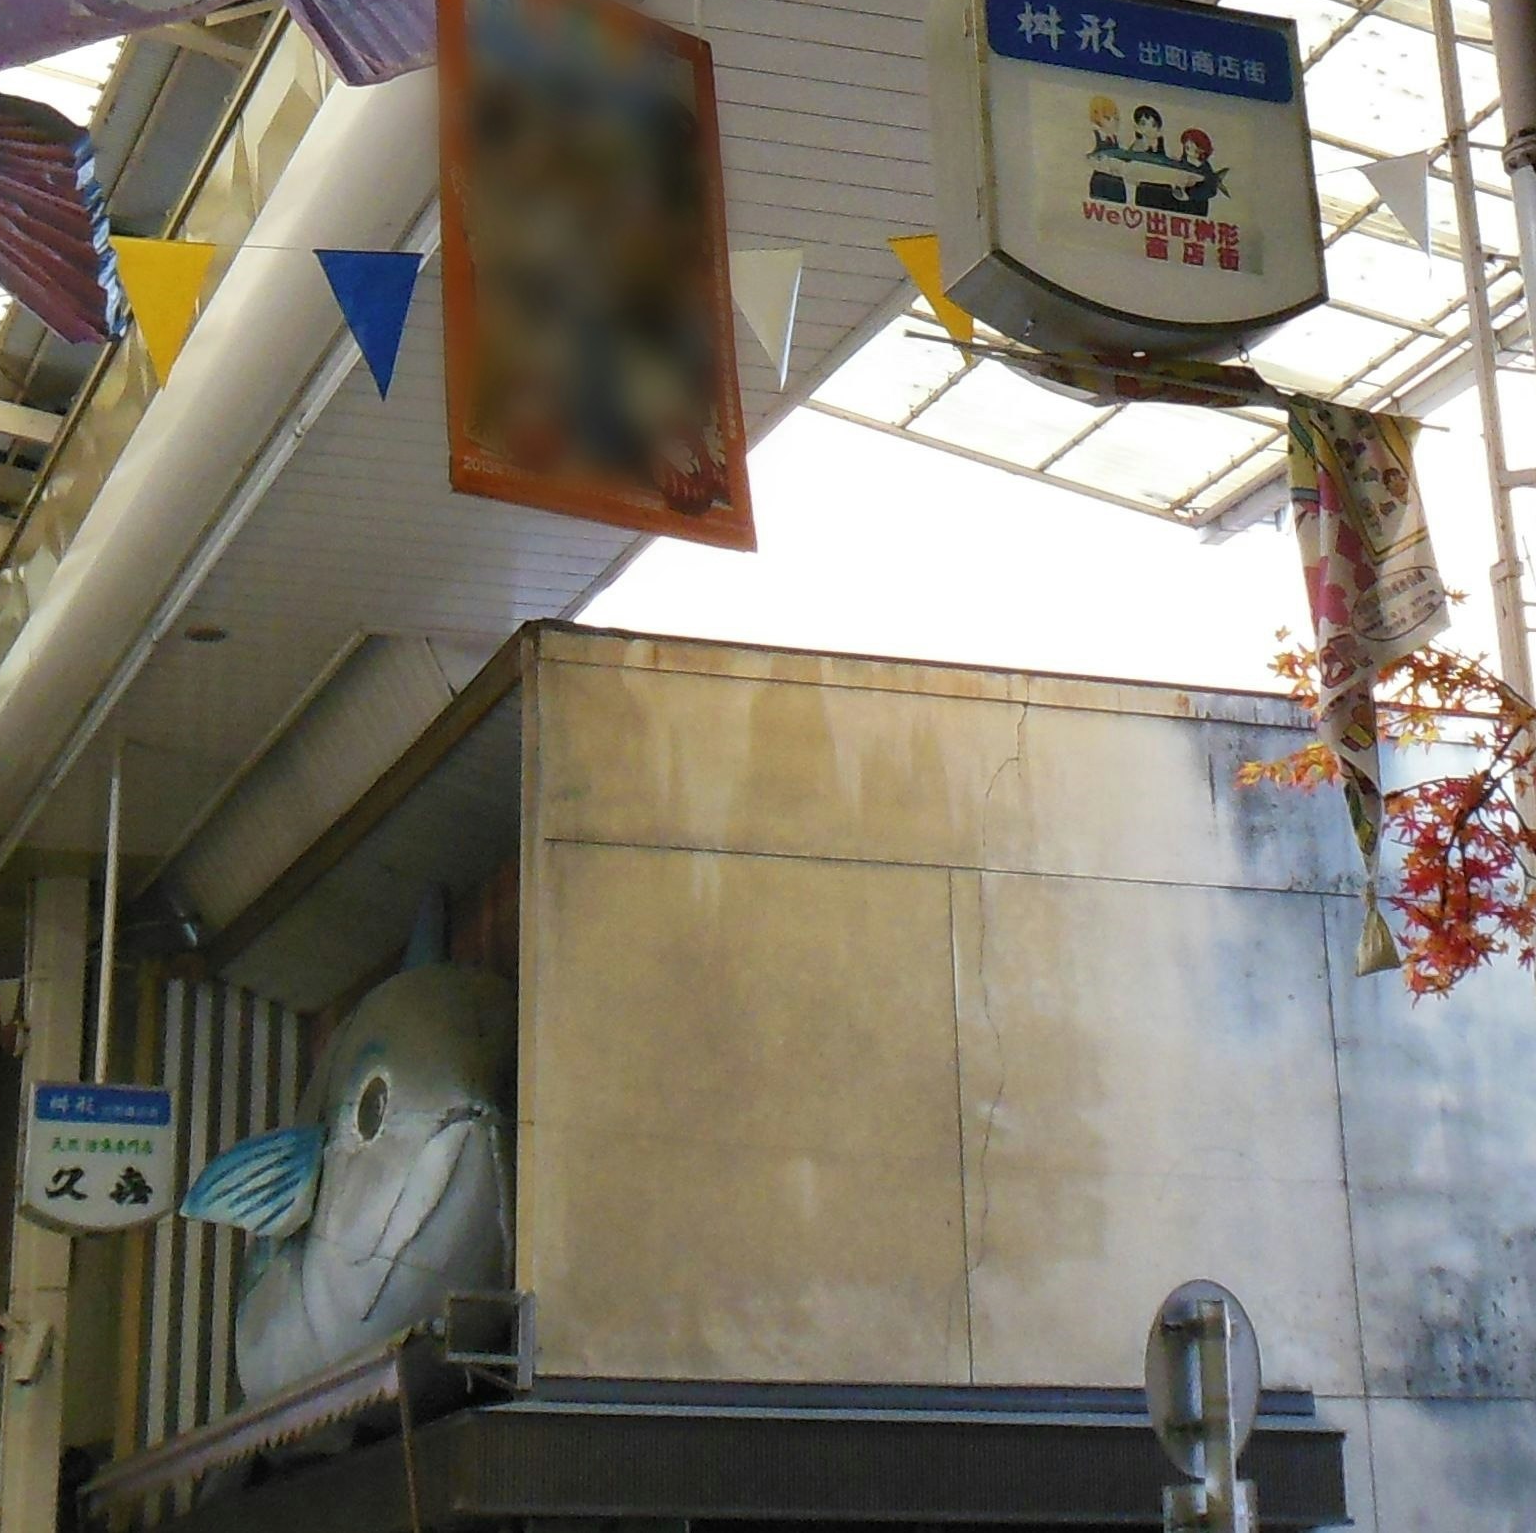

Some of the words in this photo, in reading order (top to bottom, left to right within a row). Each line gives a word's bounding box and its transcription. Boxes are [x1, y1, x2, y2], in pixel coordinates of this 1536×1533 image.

[1016, 1, 1126, 58] 桝形
[1138, 40, 1266, 84] 出町商店街
[1082, 201, 1121, 225] We
